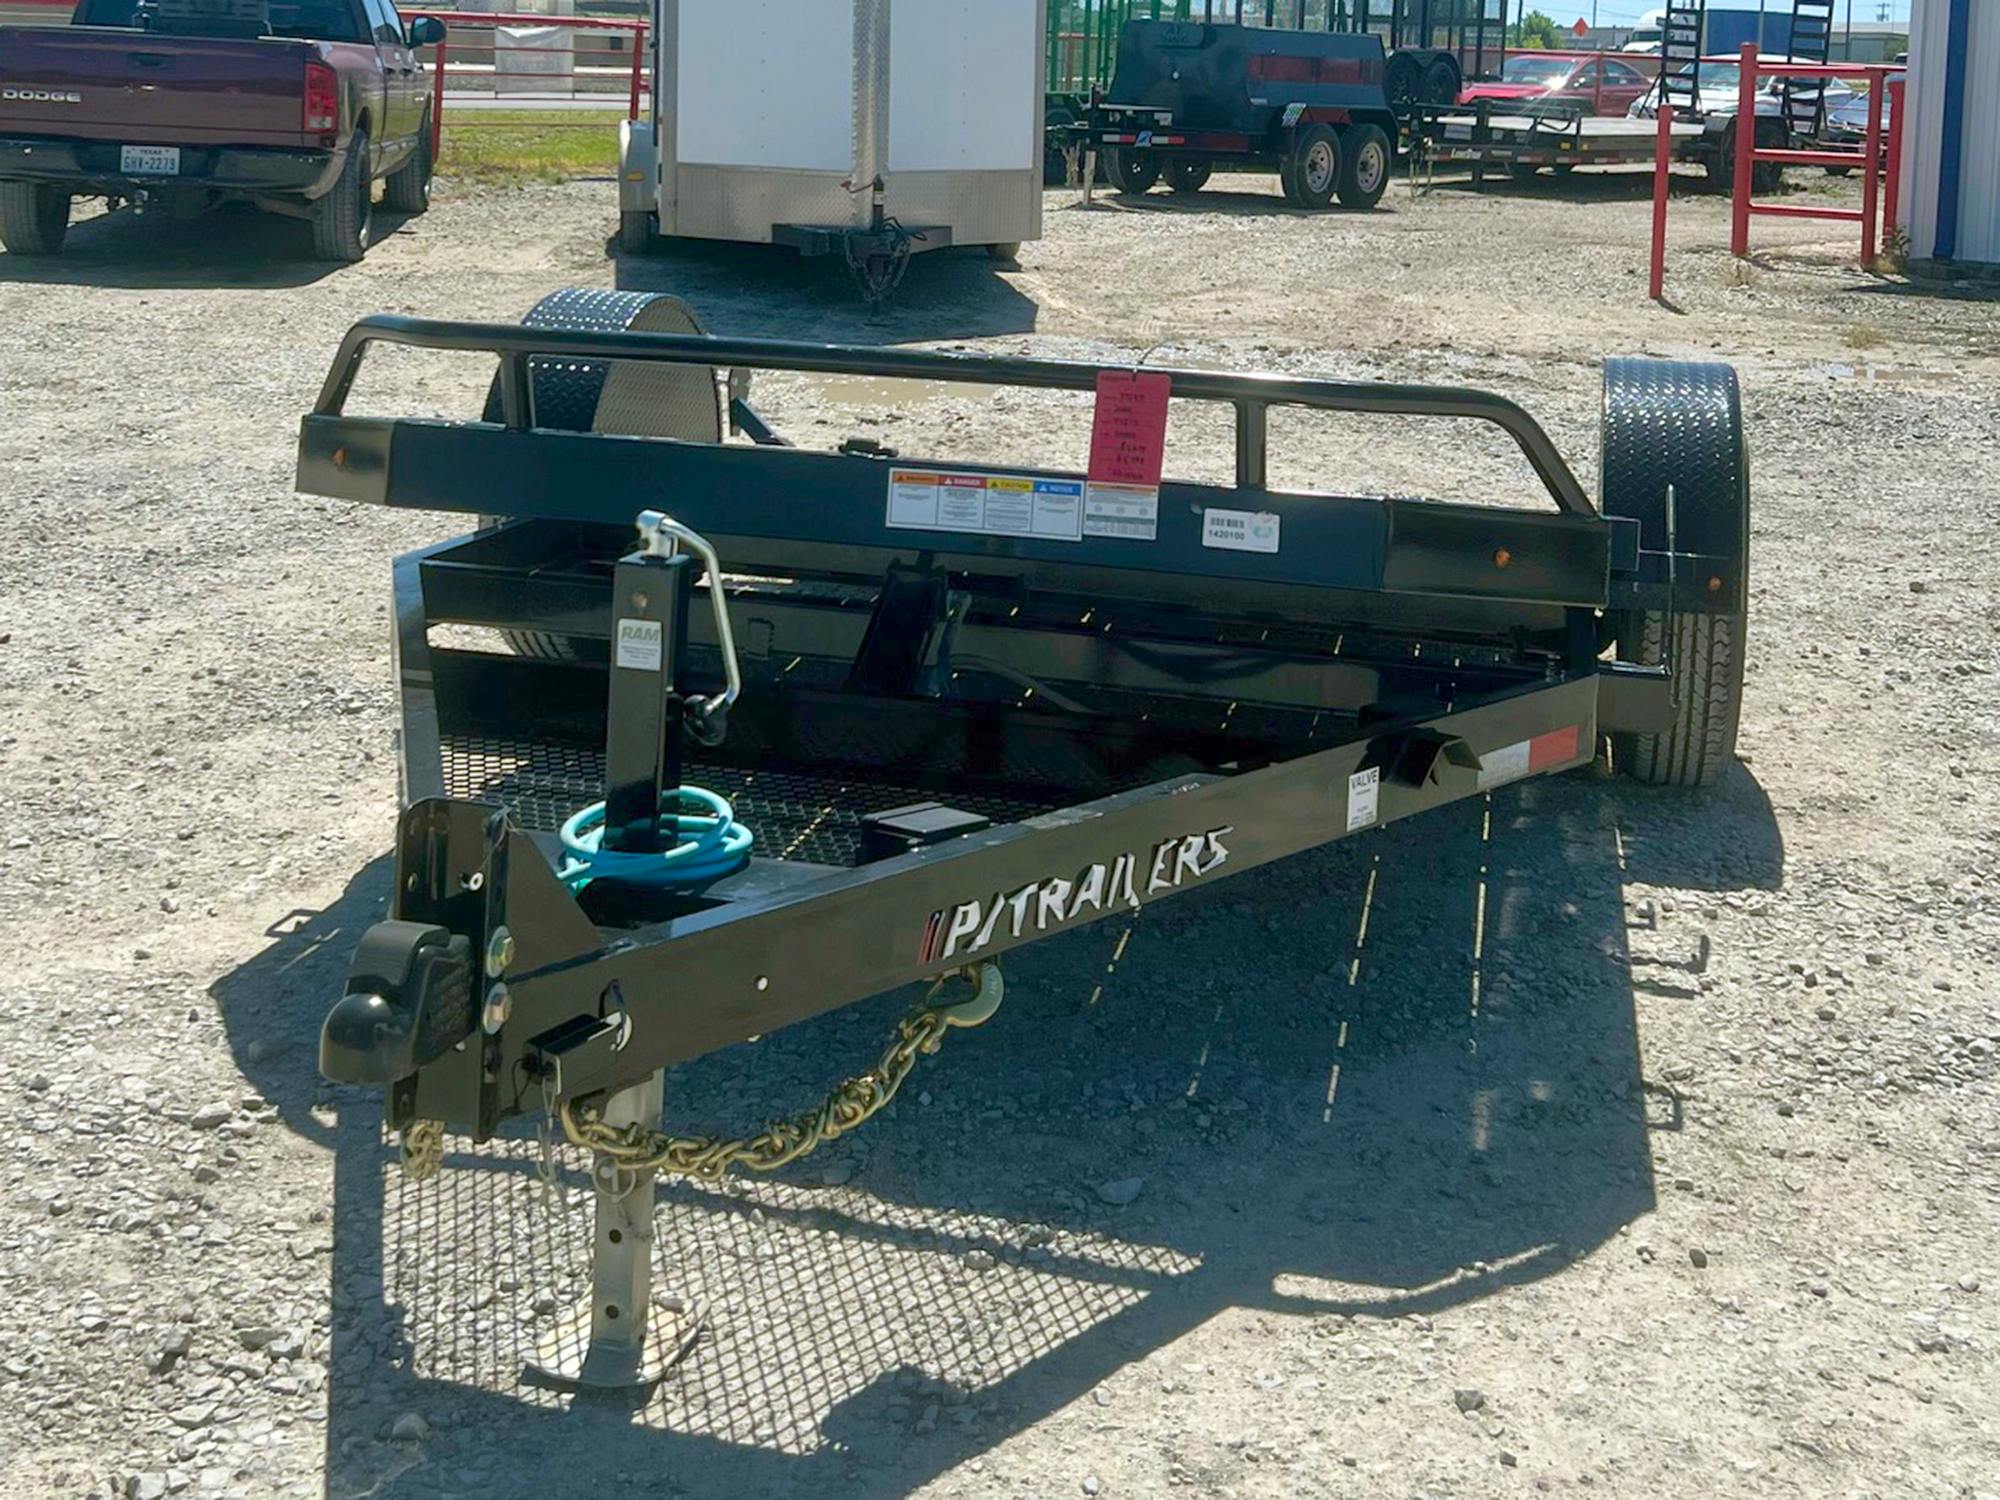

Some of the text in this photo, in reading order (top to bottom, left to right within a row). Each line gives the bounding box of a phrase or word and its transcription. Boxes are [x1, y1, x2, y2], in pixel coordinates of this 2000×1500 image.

[3, 89, 81, 102] DODGE
[953, 478, 981, 486] DANGER
[1208, 529, 1245, 541] 1420100
[622, 626, 659, 642] RAM
[1351, 769, 1377, 789] VALVE
